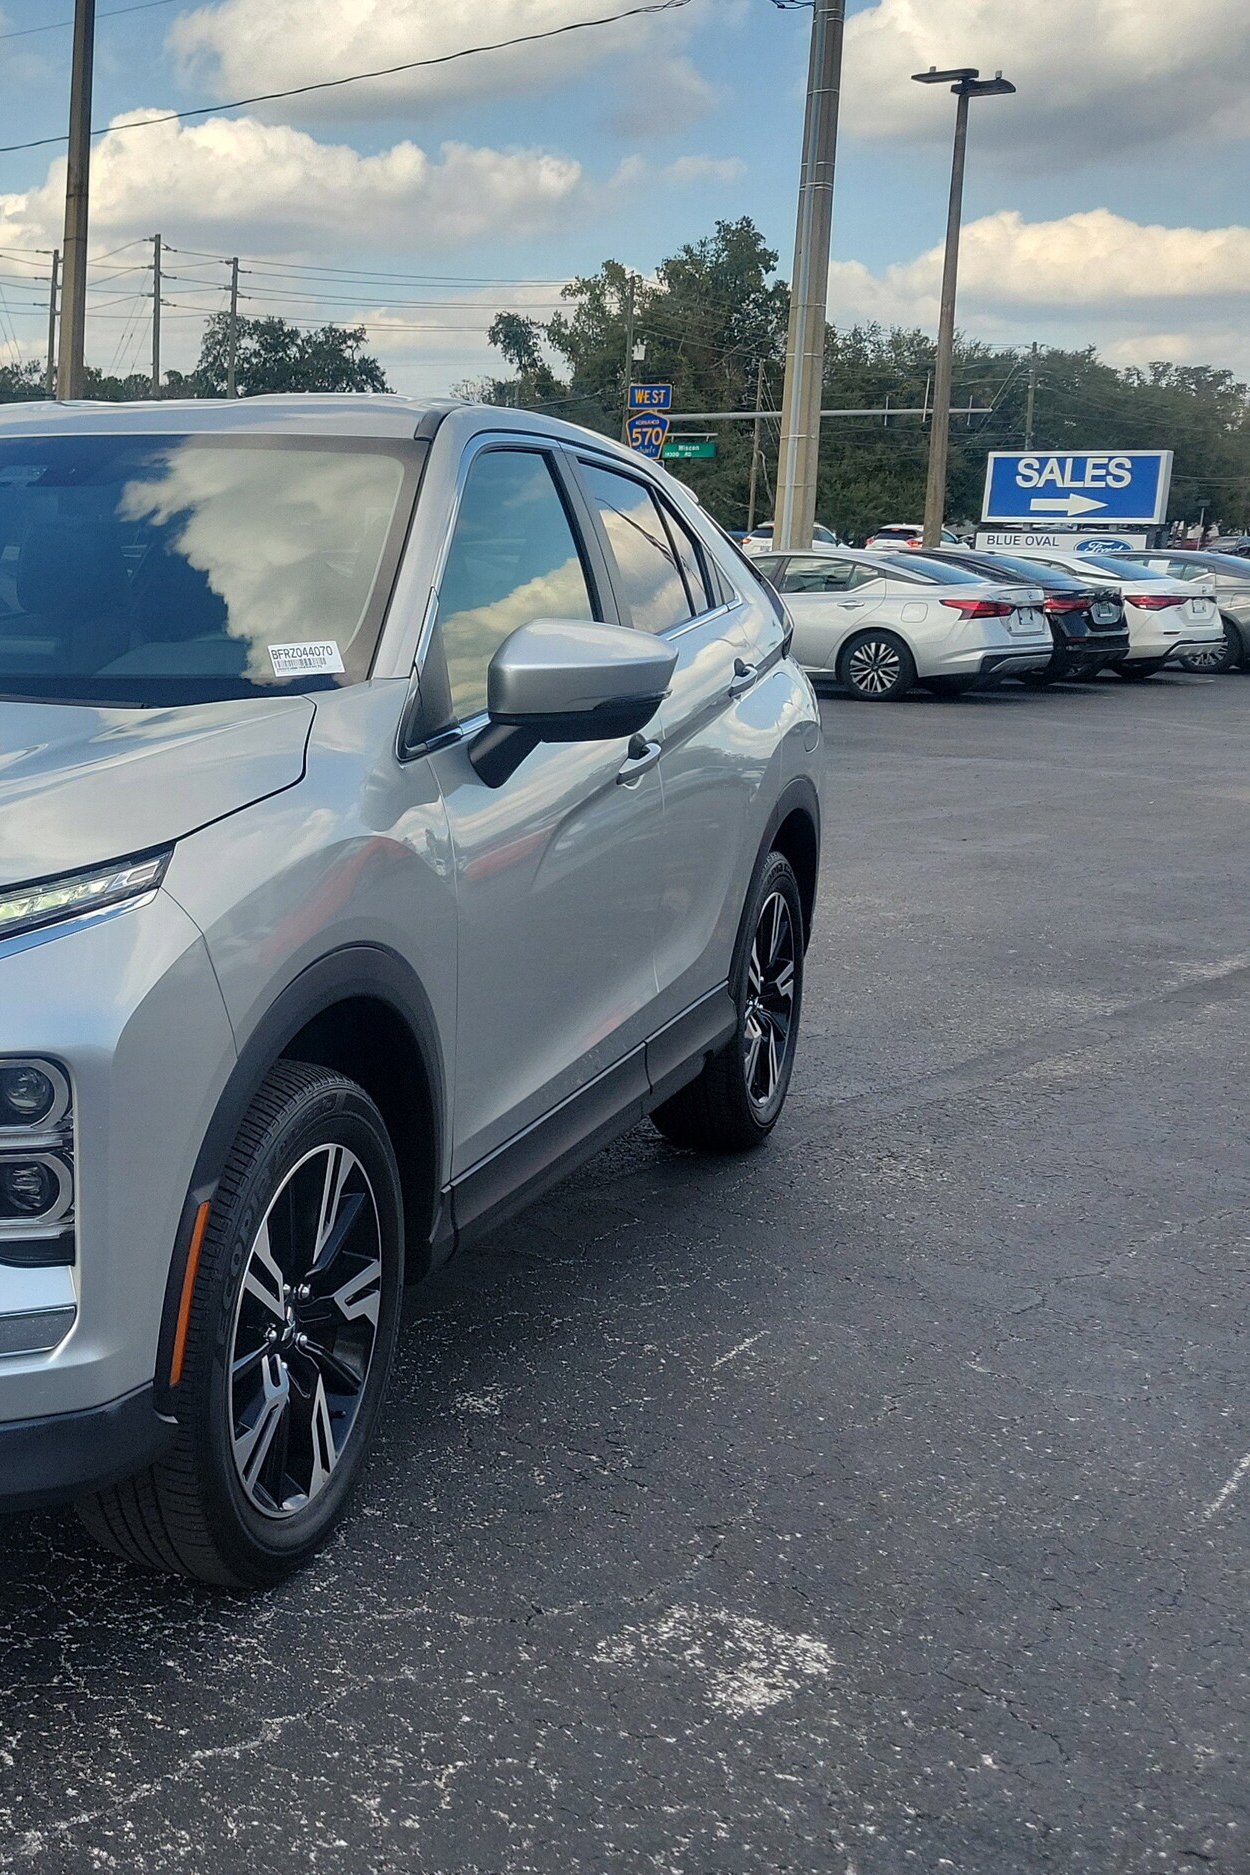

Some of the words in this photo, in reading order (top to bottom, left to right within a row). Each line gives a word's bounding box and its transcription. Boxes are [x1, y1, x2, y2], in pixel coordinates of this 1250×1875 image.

[635, 389, 666, 404] WEST
[632, 427, 663, 446] 570
[1016, 457, 1132, 488] SALES
[986, 535, 1022, 546] BLUE
[1025, 536, 1060, 547] OVAL
[271, 645, 333, 660] BFRZ044070
